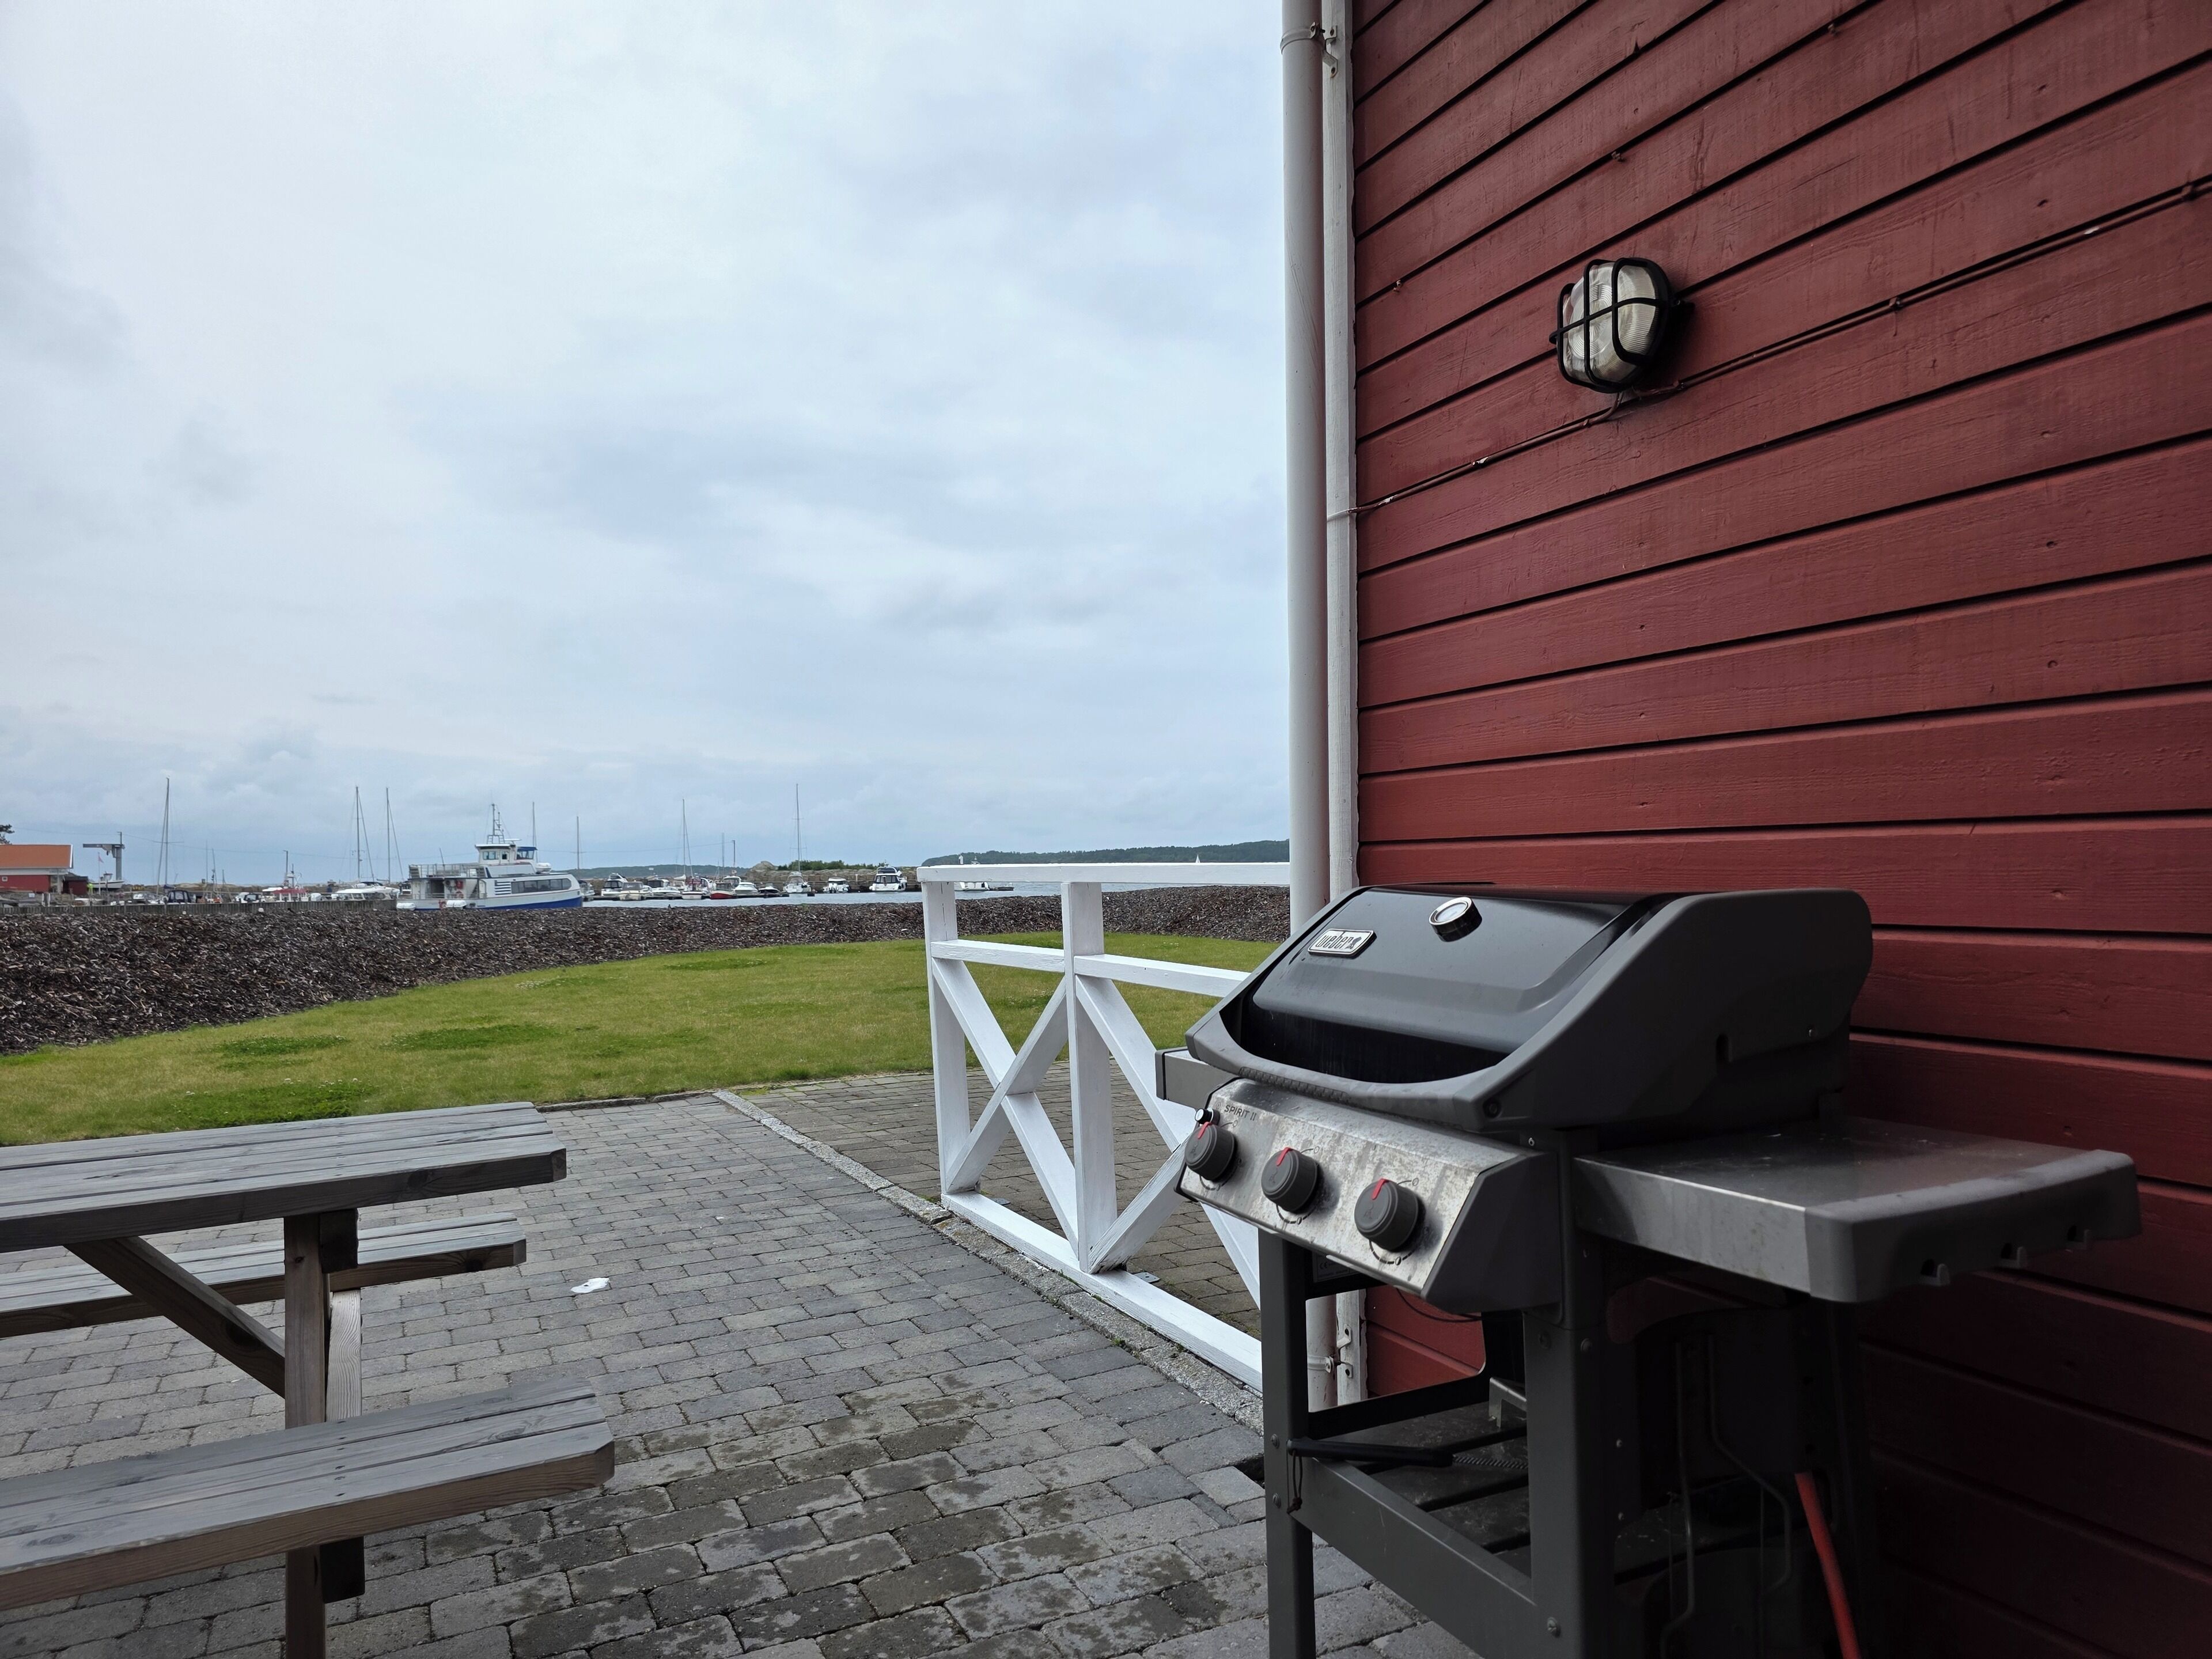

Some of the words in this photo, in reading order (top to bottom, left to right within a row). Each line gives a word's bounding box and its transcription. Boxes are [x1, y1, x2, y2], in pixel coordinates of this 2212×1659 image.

[1315, 931, 1354, 949] weber
[1224, 1105, 1249, 1118] SPIRIT
[1250, 1112, 1257, 1121] II
